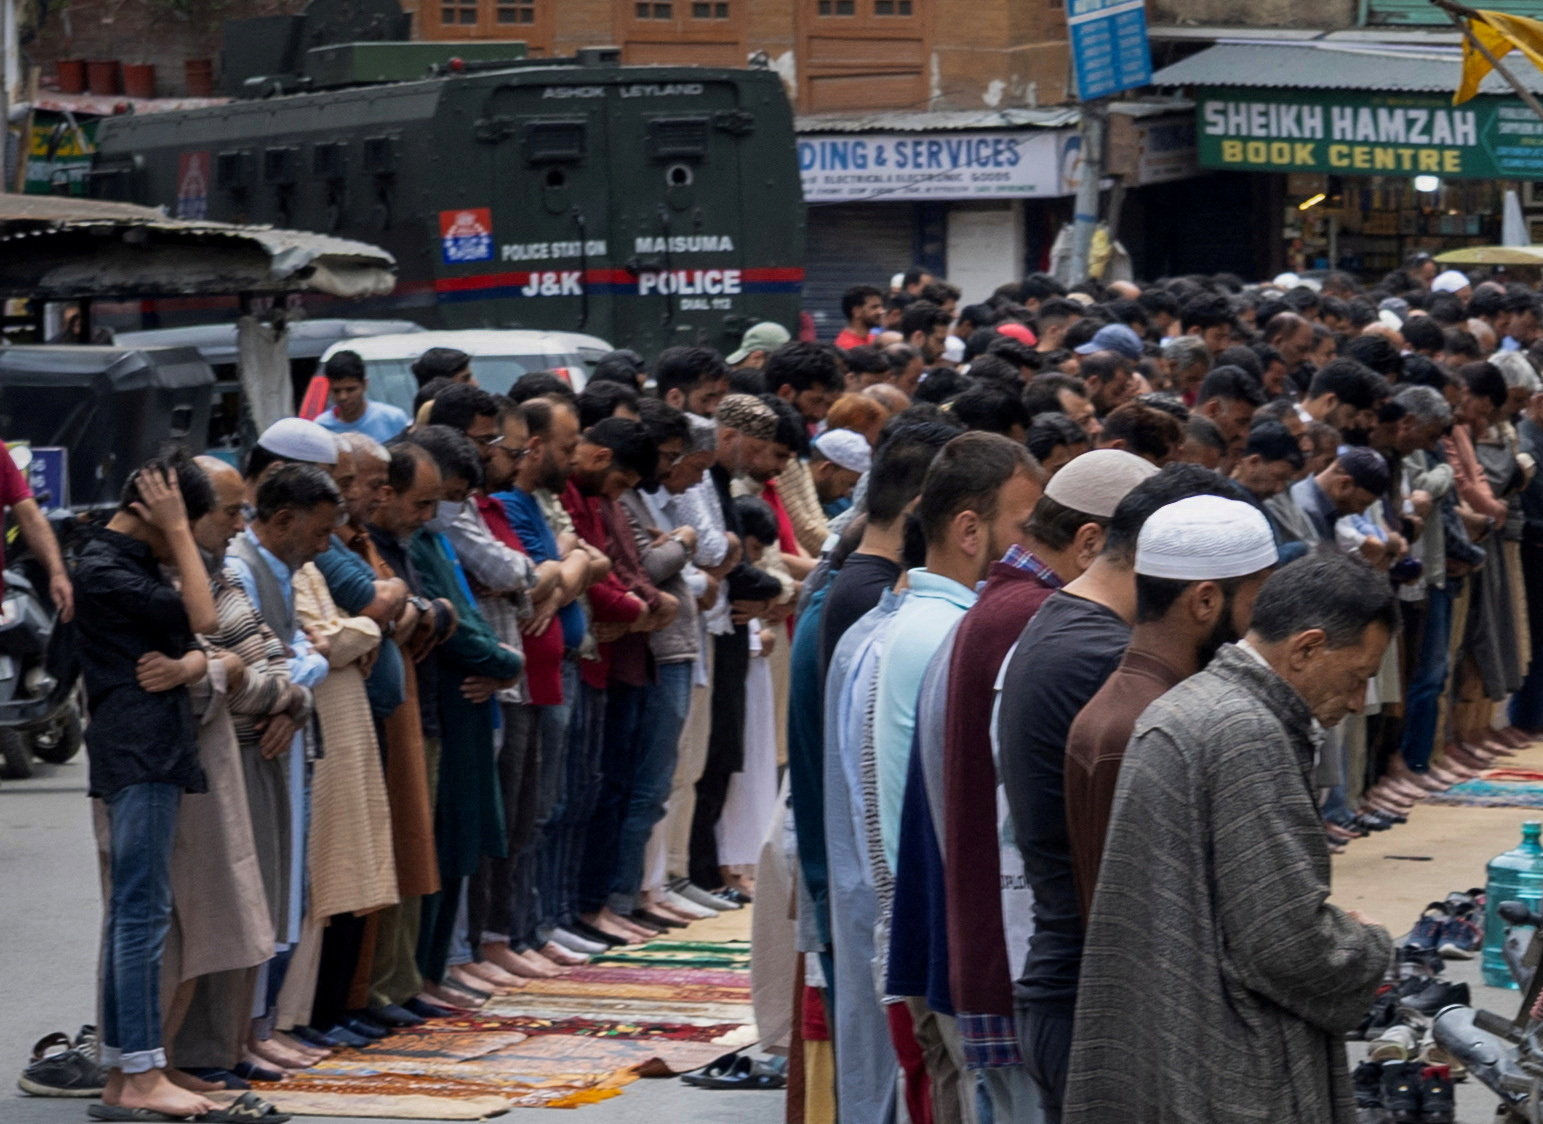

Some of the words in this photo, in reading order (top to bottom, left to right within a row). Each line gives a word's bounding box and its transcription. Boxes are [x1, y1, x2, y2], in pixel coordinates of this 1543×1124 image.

[543, 86, 606, 99] ASHOK
[619, 83, 703, 98] LEYLAND
[1204, 100, 1324, 139] SHEIKH
[1330, 105, 1477, 146] HAMZAH
[874, 144, 888, 167] &
[894, 138, 1021, 169] SERVICES
[1220, 140, 1317, 166] BOOK
[1327, 144, 1462, 172] CENTRE
[501, 242, 549, 261] POLICE
[550, 240, 607, 258] STATON
[634, 235, 735, 254] MAISUMA
[521, 270, 584, 297] J&K
[637, 269, 742, 296] POLICE
